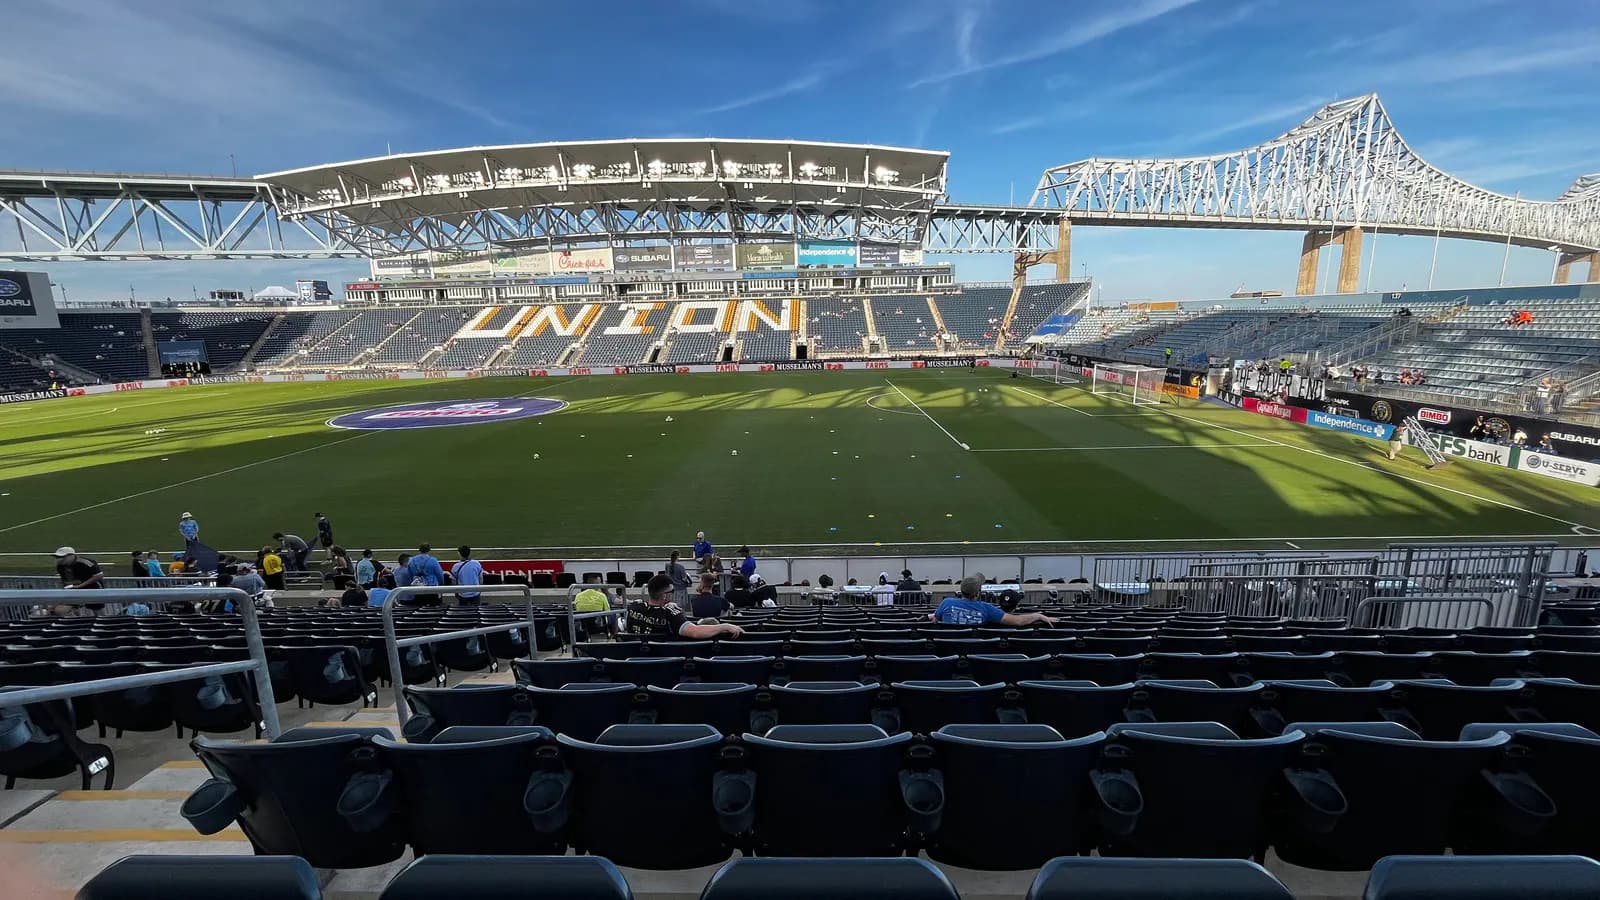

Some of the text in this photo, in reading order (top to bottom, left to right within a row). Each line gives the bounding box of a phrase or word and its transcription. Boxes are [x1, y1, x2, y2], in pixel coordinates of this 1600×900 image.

[630, 255, 670, 263] SUBARU
[799, 248, 847, 258] Independence
[453, 299, 800, 339] UNION
[628, 365, 673, 374] MUSSELMAN'S
[715, 363, 740, 373] FAMILY
[775, 361, 821, 371] MUSSELMAN'S
[865, 362, 889, 370] FARMS
[1014, 360, 1039, 370] FAMILY
[113, 382, 144, 392] FAMILY
[1299, 375, 1325, 402] END
[0, 389, 65, 404] MUSSELMAN'S
[1420, 409, 1449, 423] BIMBO
[1314, 413, 1373, 434] Independence
[1550, 431, 1600, 447] SUBARU
[1468, 446, 1502, 465] bank
[1542, 460, 1587, 476] U-SERVE
